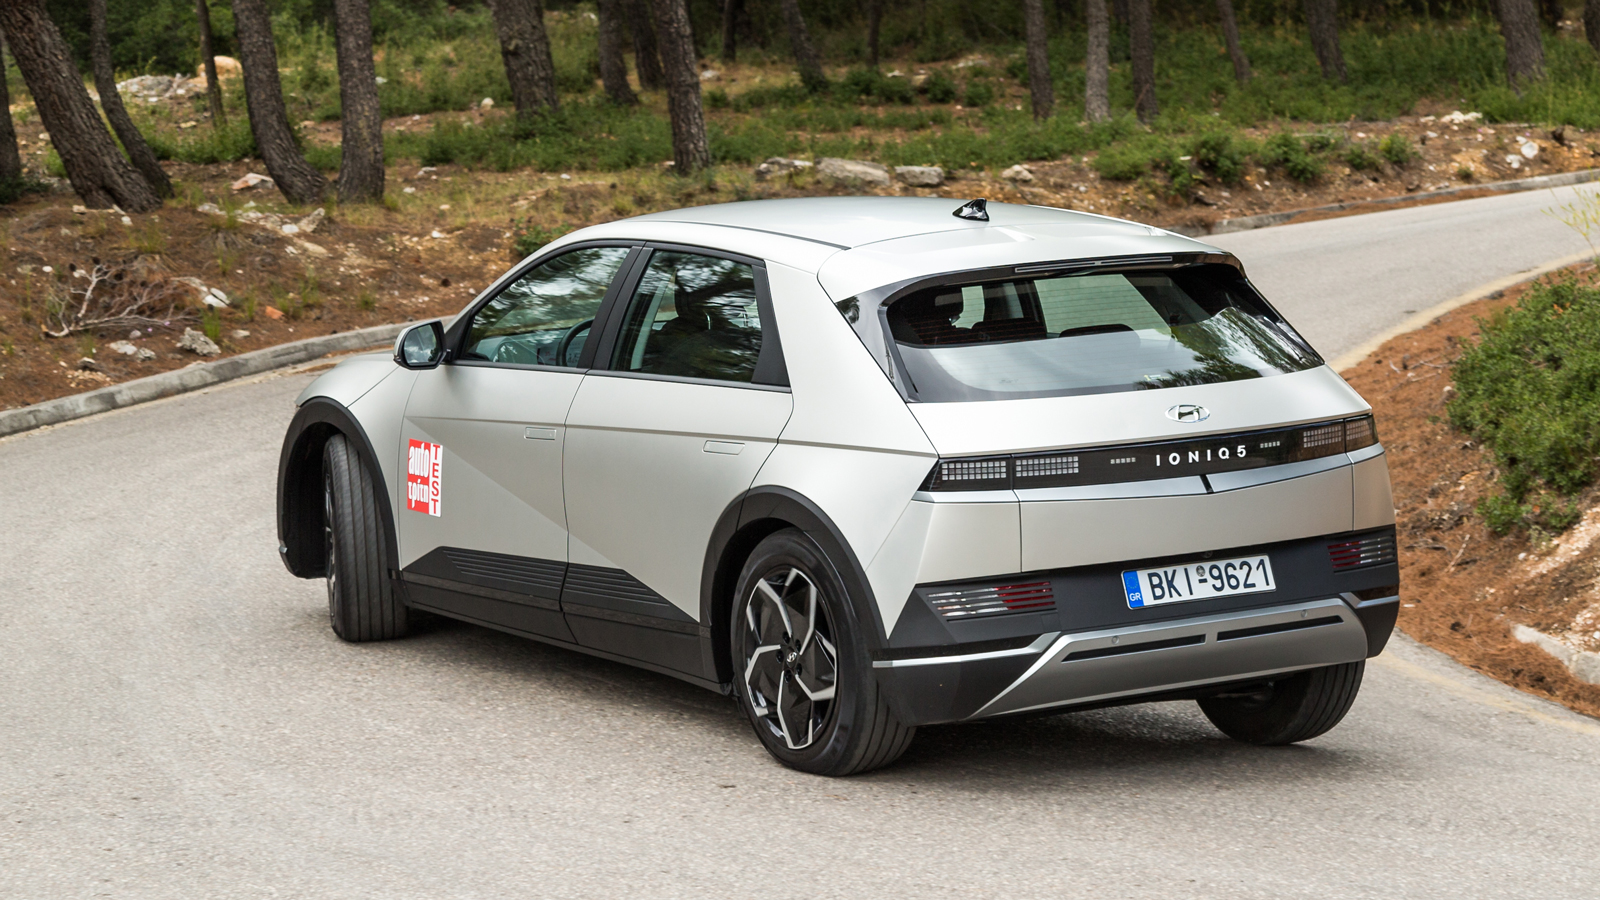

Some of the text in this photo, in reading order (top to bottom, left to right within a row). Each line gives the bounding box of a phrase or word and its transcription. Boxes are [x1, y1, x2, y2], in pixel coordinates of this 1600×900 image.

[408, 442, 430, 478] auto
[1155, 445, 1247, 467] IONIQ 5
[431, 444, 441, 515] TEST
[1129, 592, 1142, 602] GR
